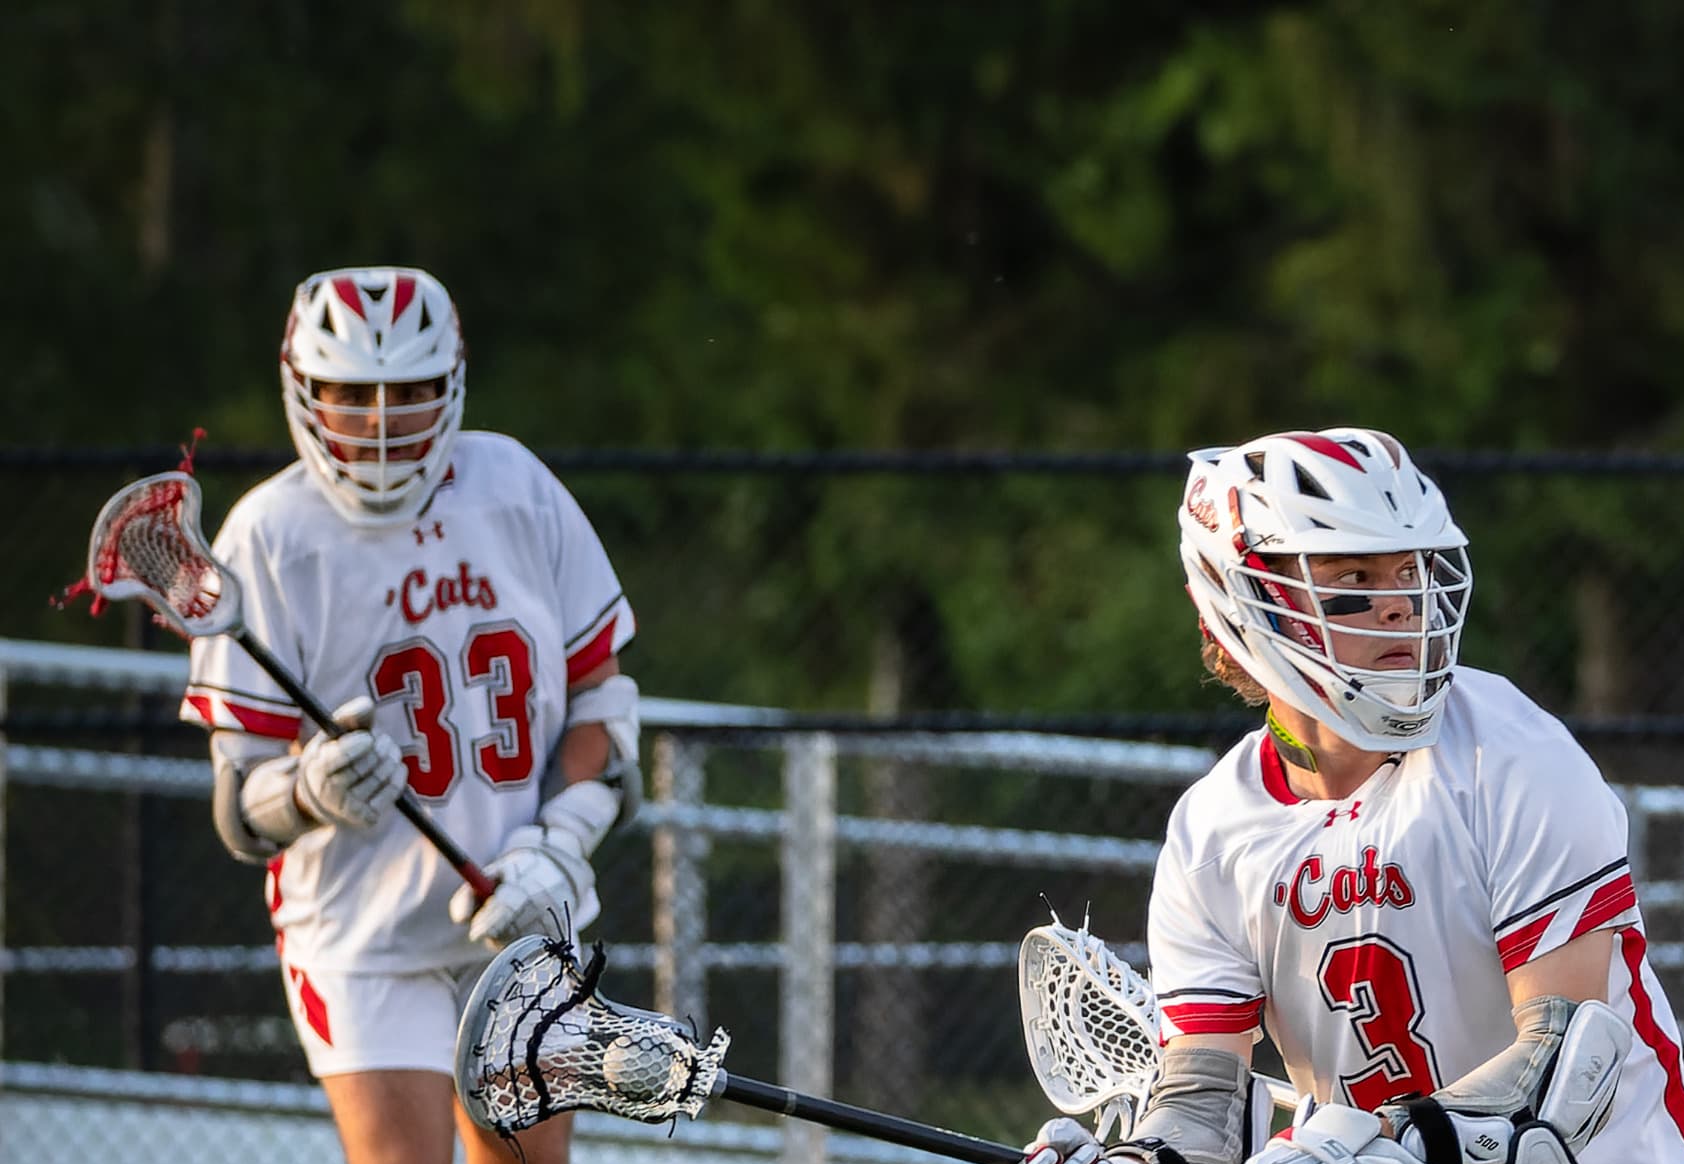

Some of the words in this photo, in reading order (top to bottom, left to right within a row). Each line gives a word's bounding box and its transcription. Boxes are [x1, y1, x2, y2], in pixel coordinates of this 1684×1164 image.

[385, 561, 498, 625] 'Cats
[367, 617, 537, 807] 33
[1274, 844, 1415, 929] 'Cats
[1316, 933, 1443, 1113] 3
[1474, 1134, 1500, 1151] 500
